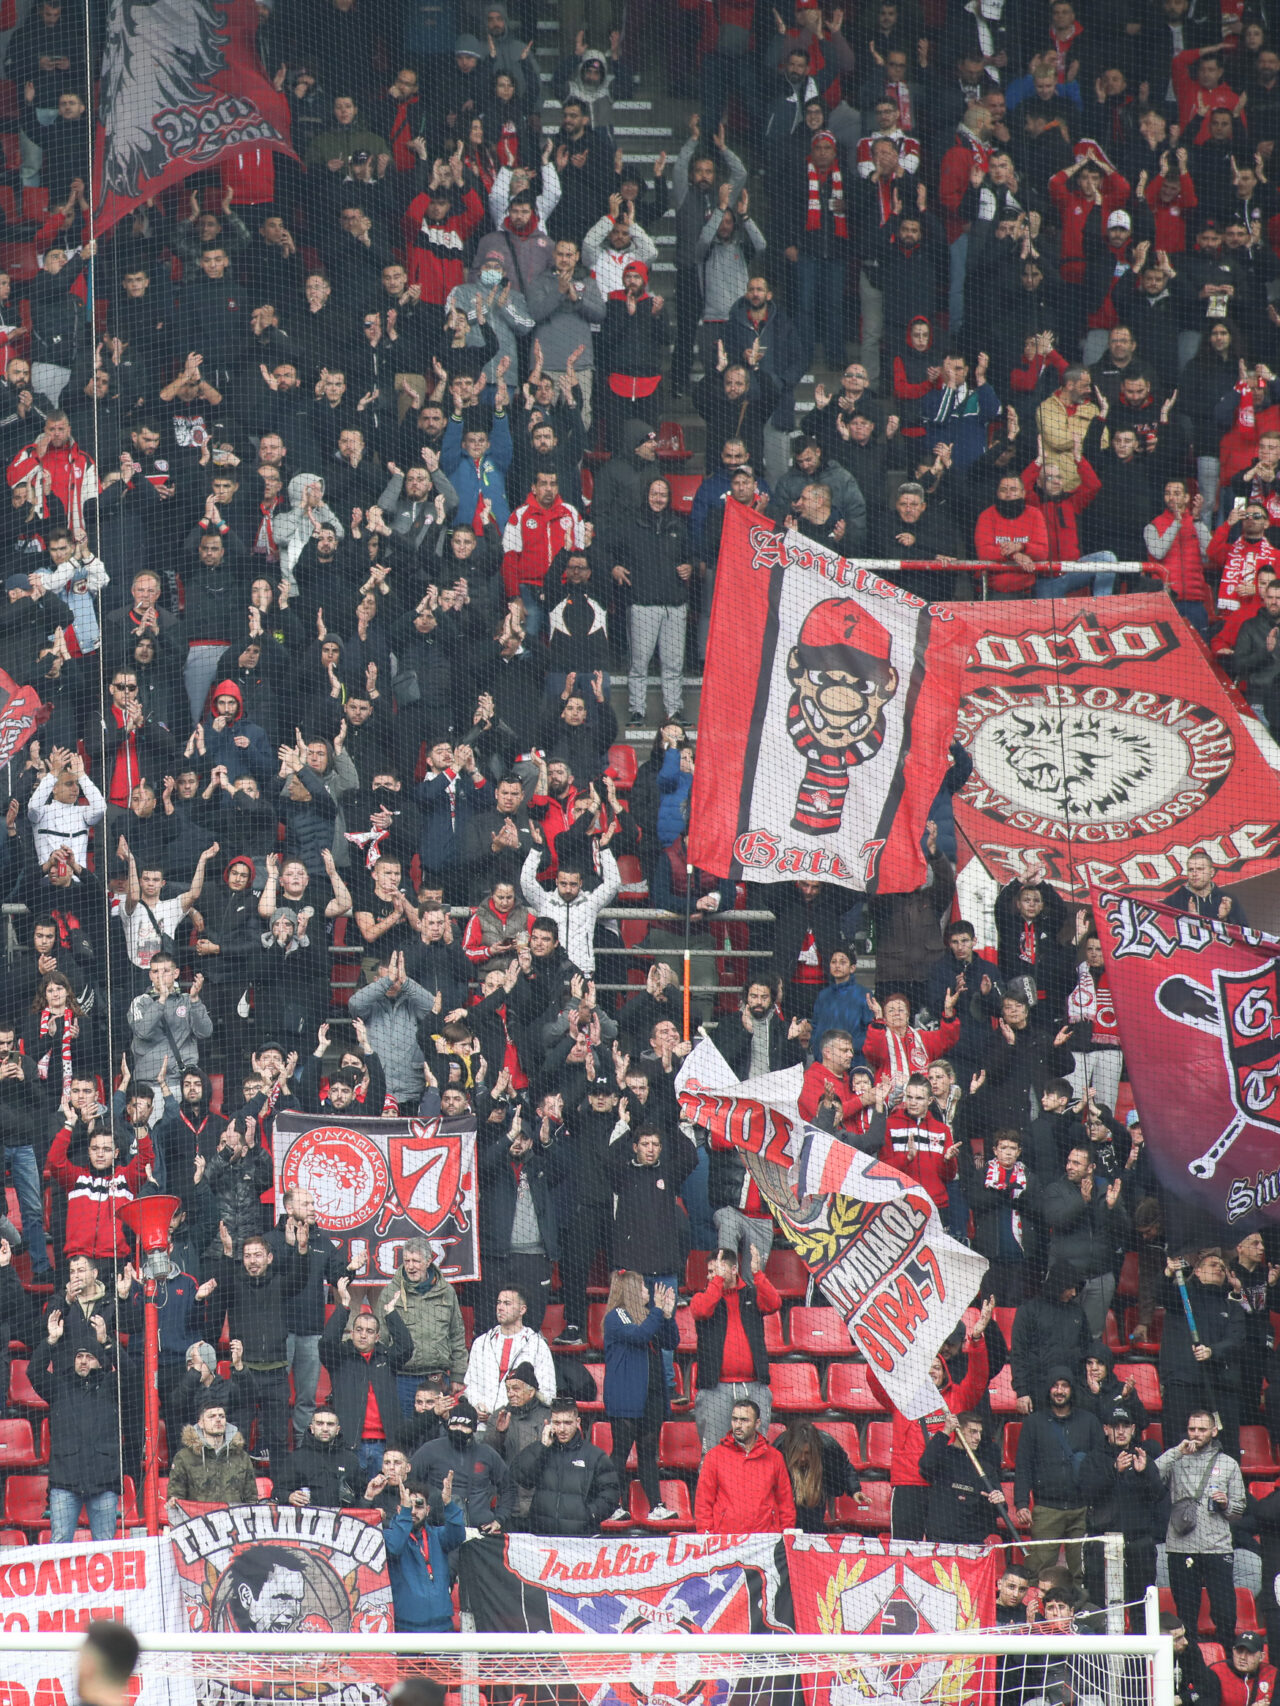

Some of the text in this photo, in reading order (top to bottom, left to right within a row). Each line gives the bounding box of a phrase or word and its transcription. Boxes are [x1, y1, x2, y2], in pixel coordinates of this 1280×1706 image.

[966, 618, 1166, 671] orto
[1044, 685, 1197, 726] BORN
[1182, 718, 1235, 781] RED
[733, 828, 853, 880] Gate
[401, 1145, 451, 1215] 7
[637, 1603, 676, 1624] GATE
